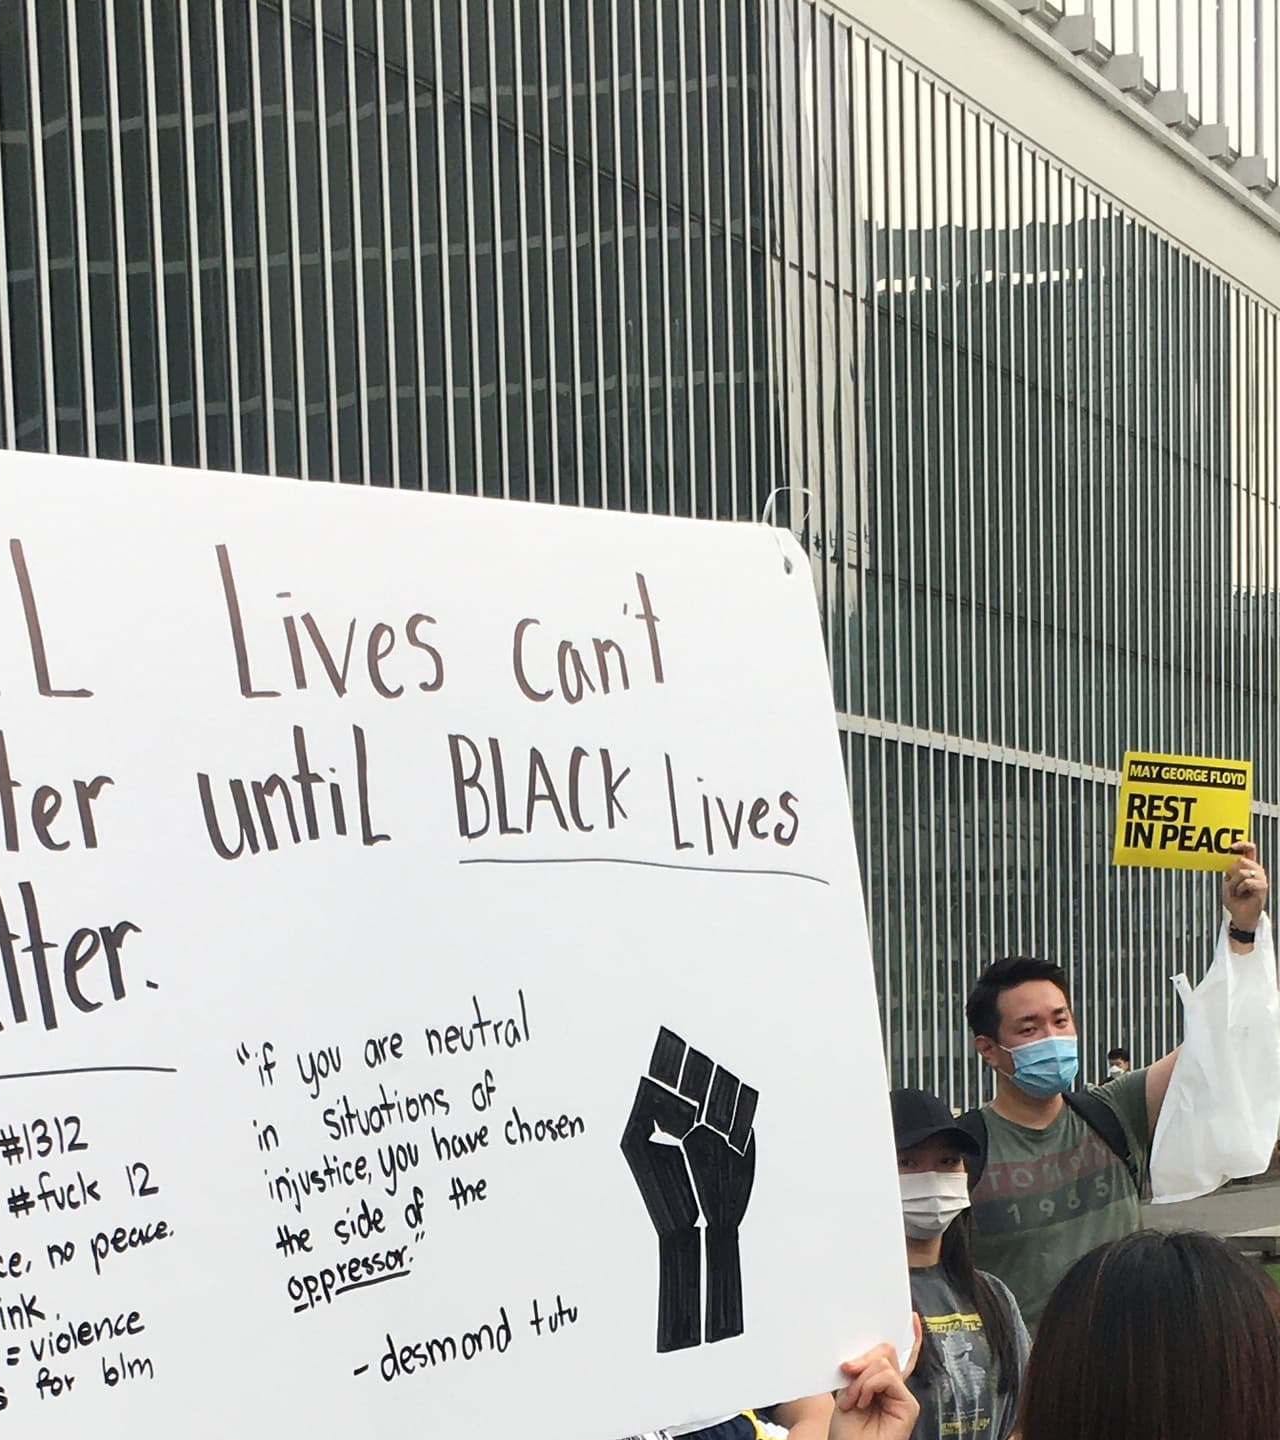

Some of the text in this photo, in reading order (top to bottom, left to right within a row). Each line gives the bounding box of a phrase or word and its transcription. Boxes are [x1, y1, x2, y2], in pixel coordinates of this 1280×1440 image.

[216, 545, 443, 698] Lives
[514, 573, 663, 703] can't
[448, 735, 630, 839] BLACK
[665, 754, 798, 855] Lives
[1130, 764, 1246, 786] MAY GEORGE FLOYD
[1126, 793, 1197, 823] REST
[1124, 821, 1244, 855] IN PEACE
[297, 1047, 341, 1099] you
[365, 1033, 402, 1068] are
[426, 990, 529, 1055] neutral
[253, 1069, 496, 1151] in situations of
[126, 1163, 158, 1196] 12
[265, 1107, 584, 1213] injustice, you have chosen
[276, 1177, 486, 1257] the side of the
[47, 1242, 74, 1268] no
[31, 1312, 144, 1361] violence
[530, 1295, 577, 1335] tutu
[36, 1367, 74, 1399] for
[102, 1353, 153, 1386] blm
